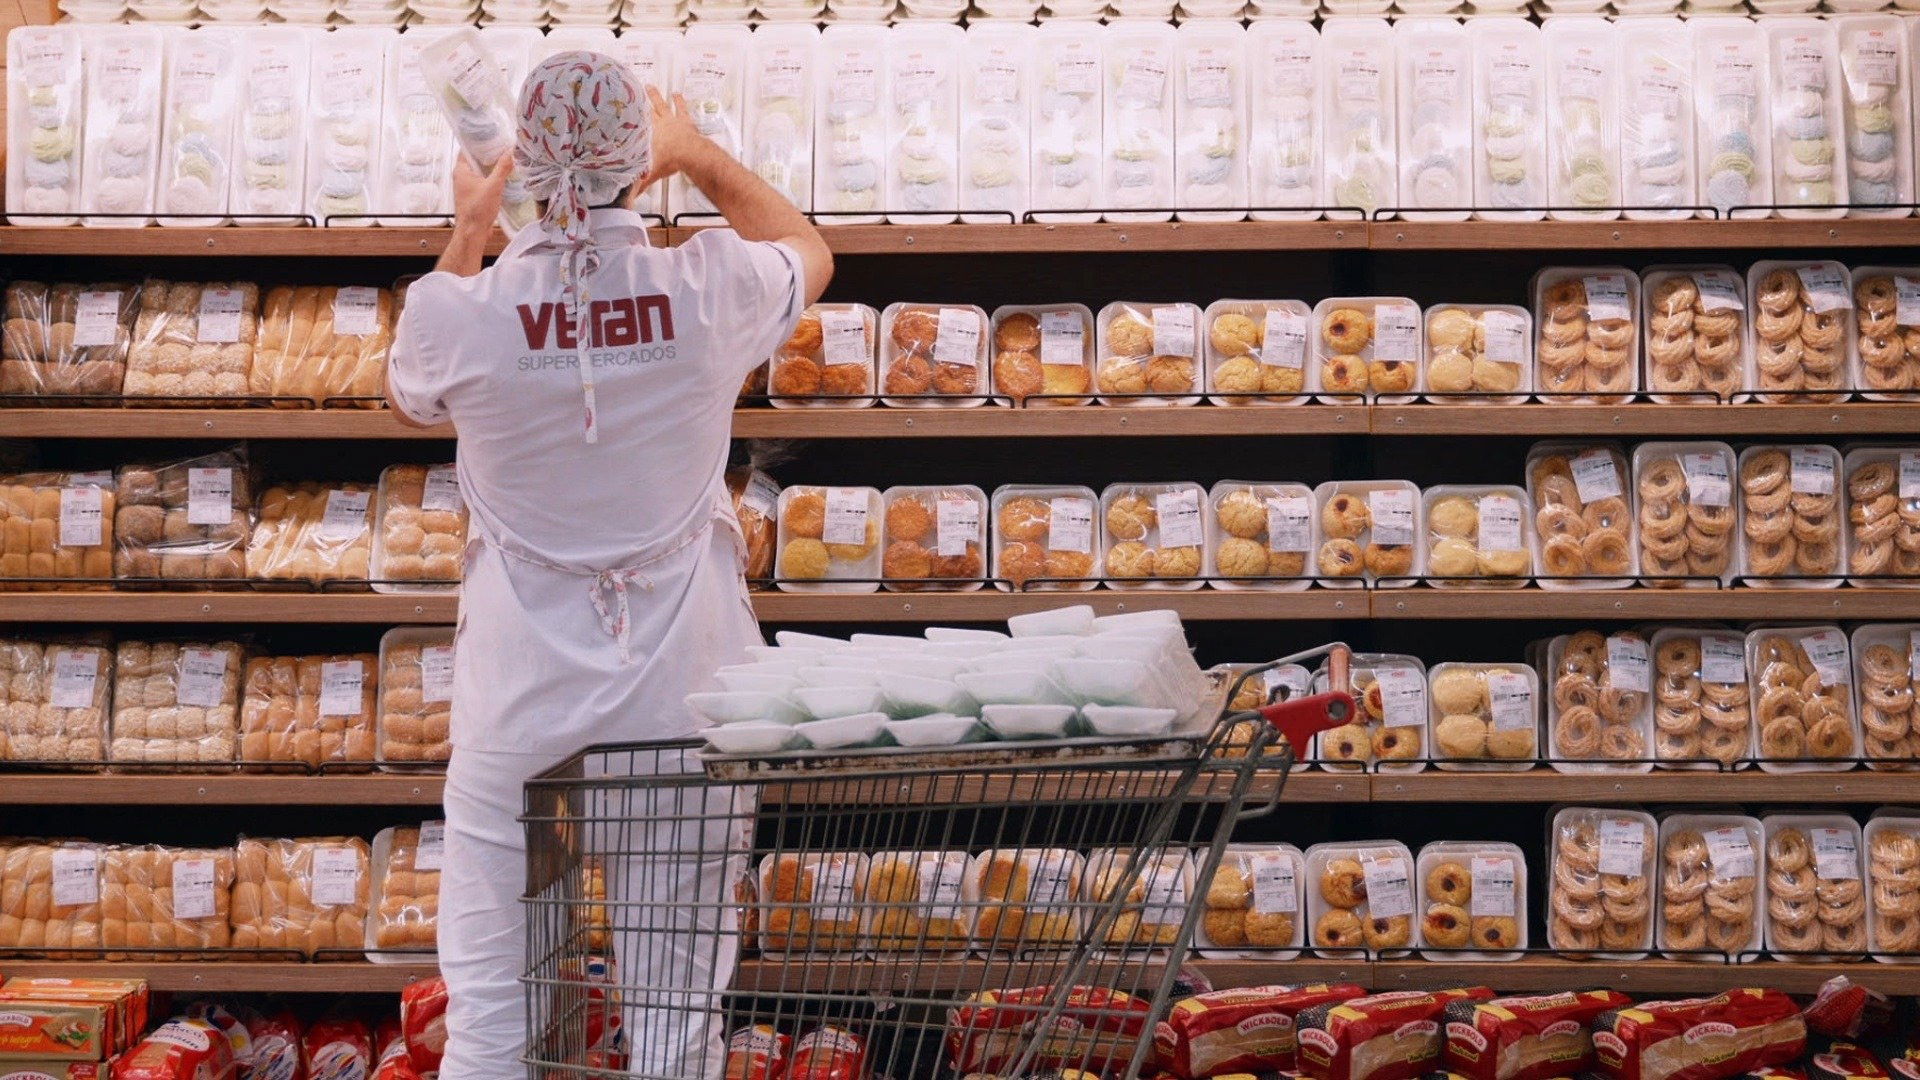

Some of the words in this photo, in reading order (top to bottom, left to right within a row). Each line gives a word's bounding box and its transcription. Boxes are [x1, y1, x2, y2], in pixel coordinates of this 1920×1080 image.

[518, 345, 676, 371] SUPERERCADOS
[1241, 1016, 1288, 1031] WICKBOLD
[1449, 1026, 1483, 1047] WICKBOLD
